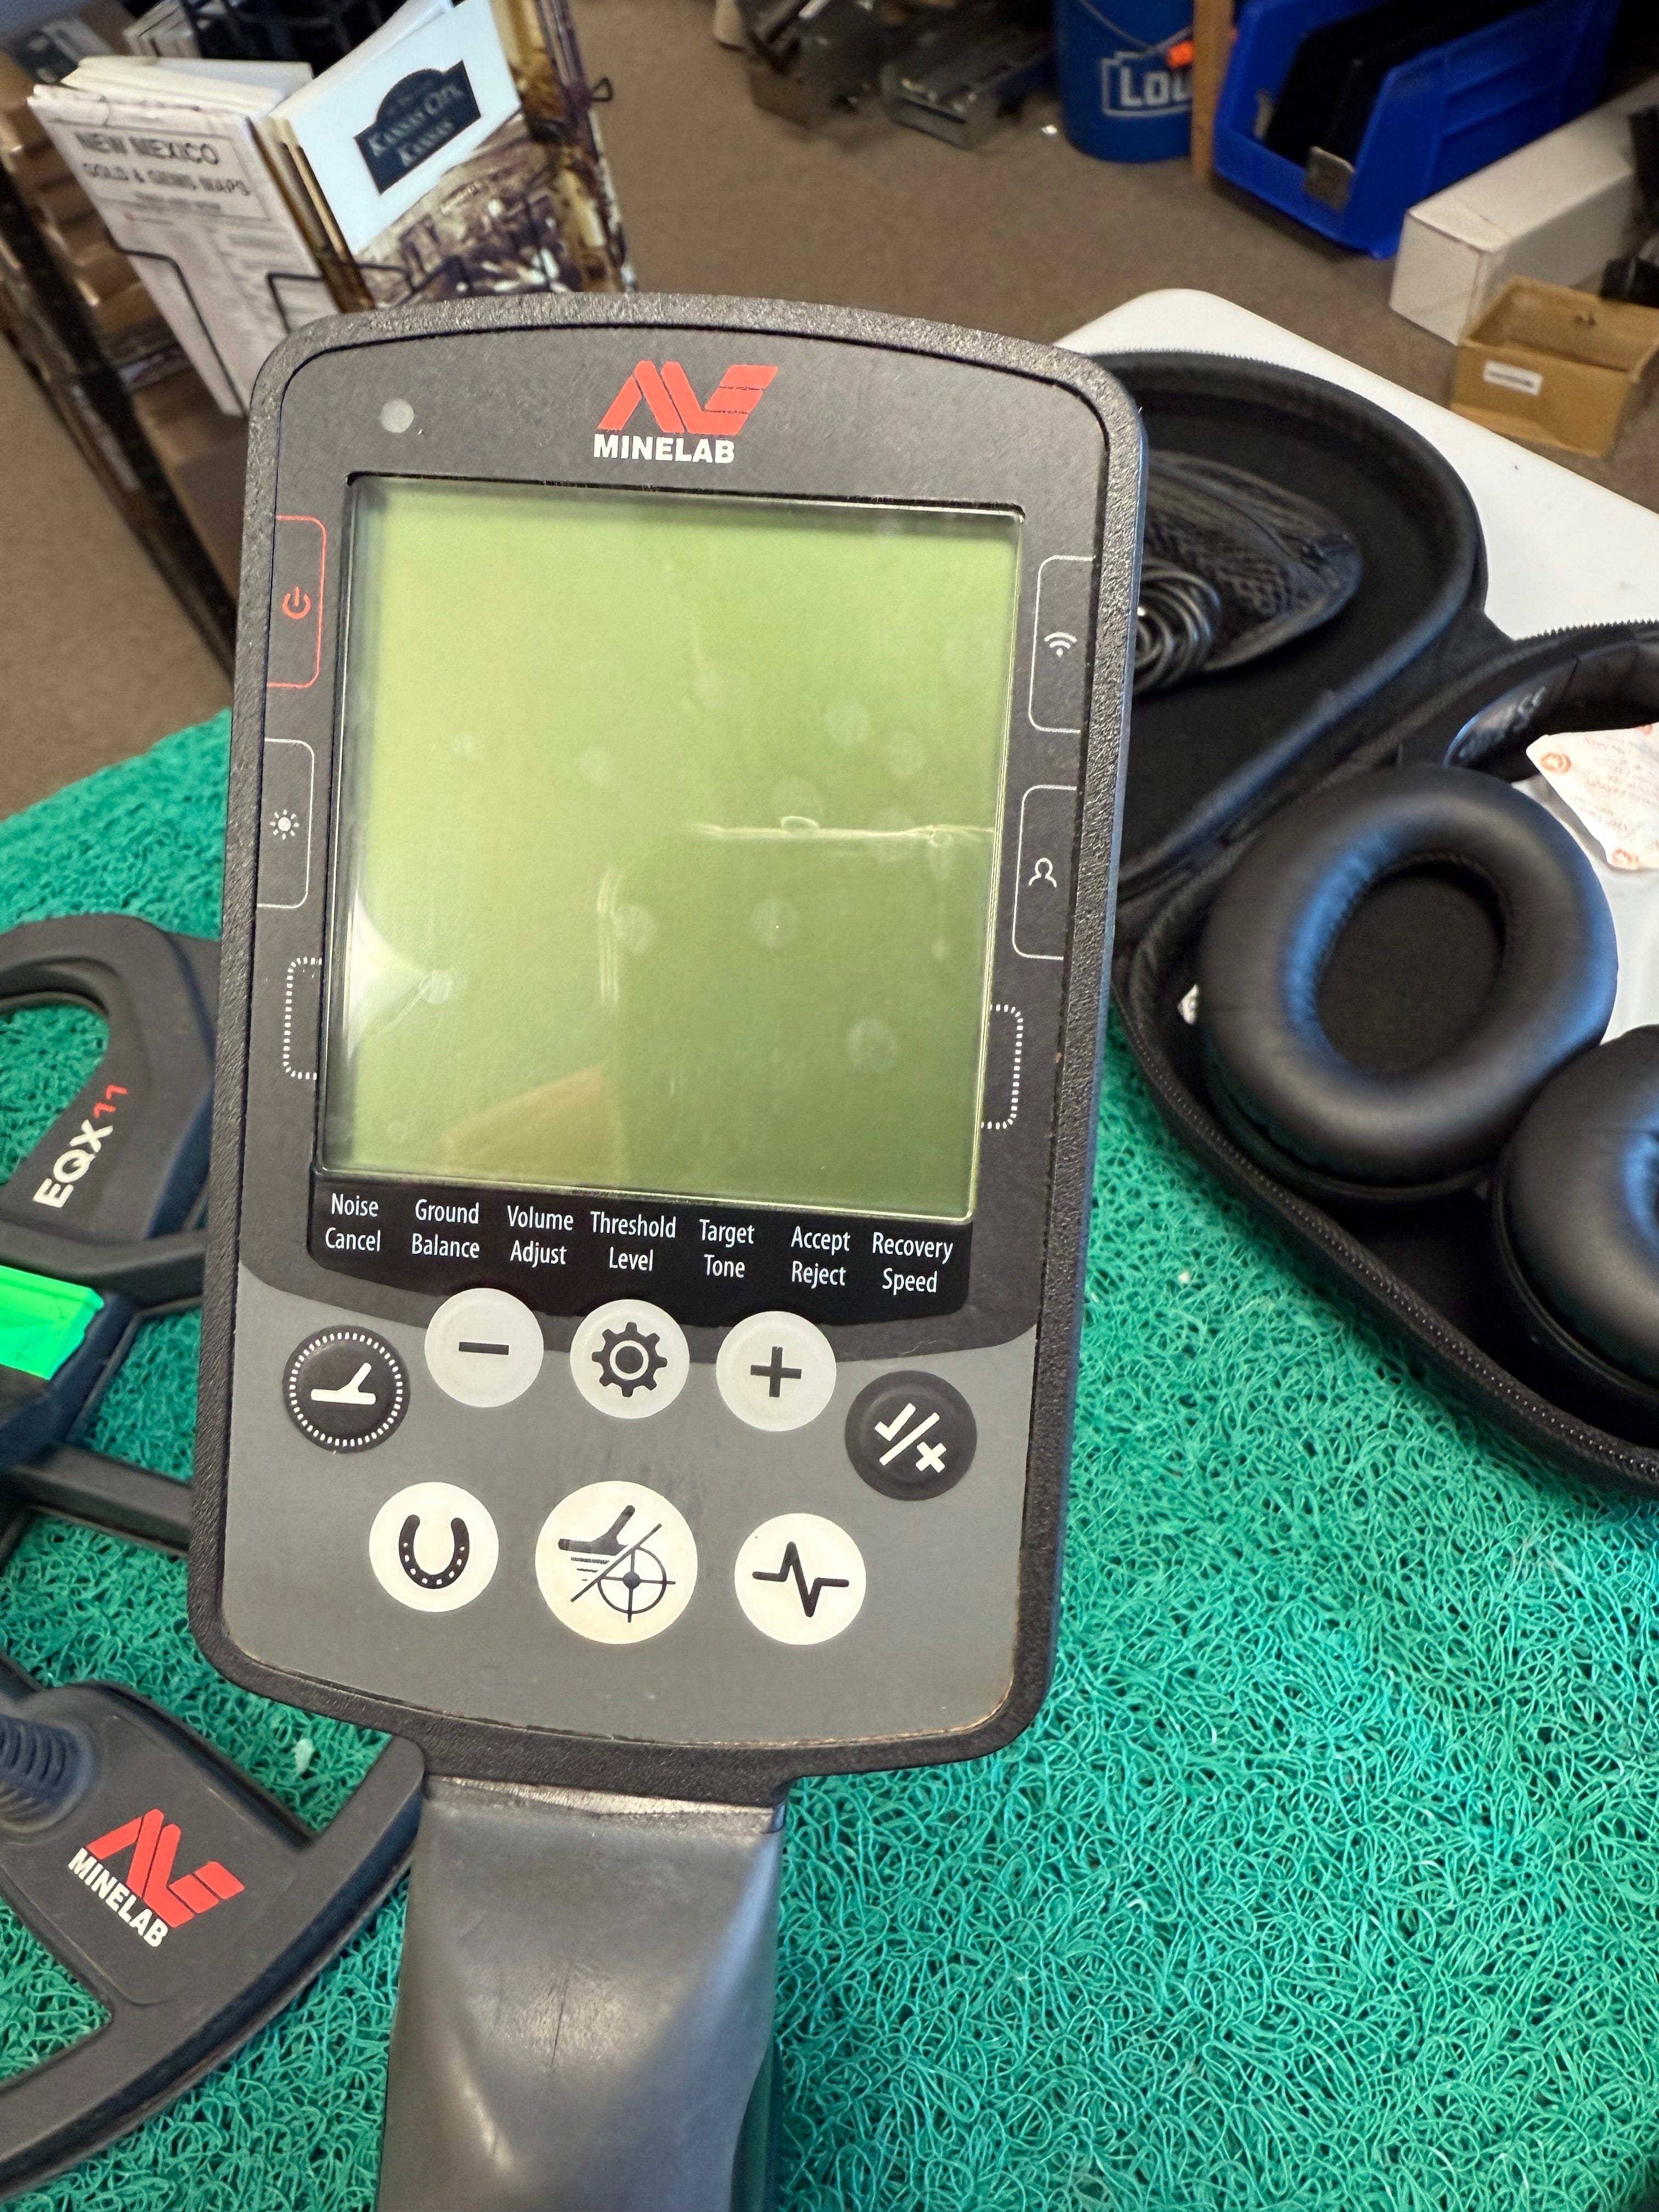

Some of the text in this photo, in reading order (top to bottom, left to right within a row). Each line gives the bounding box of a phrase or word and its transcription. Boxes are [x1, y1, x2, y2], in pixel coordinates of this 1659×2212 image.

[74, 132, 219, 165] NEW MEXICO
[593, 433, 735, 464] MINELAB
[331, 1193, 379, 1217] Noise
[415, 1199, 479, 1224] Ground
[507, 1205, 574, 1231] Volume
[590, 1211, 676, 1238] Threshold
[699, 1218, 755, 1248] Target
[325, 1227, 381, 1252] Cancel
[411, 1233, 480, 1259] Balance
[791, 1226, 851, 1256] Accept
[872, 1232, 953, 1265] Recovery
[510, 1240, 567, 1268] Adjust
[609, 1246, 653, 1271] Level
[704, 1254, 745, 1278] Tone
[792, 1260, 847, 1289] Reject
[882, 1267, 938, 1296] Speed
[67, 1847, 168, 1948] MINELAB
